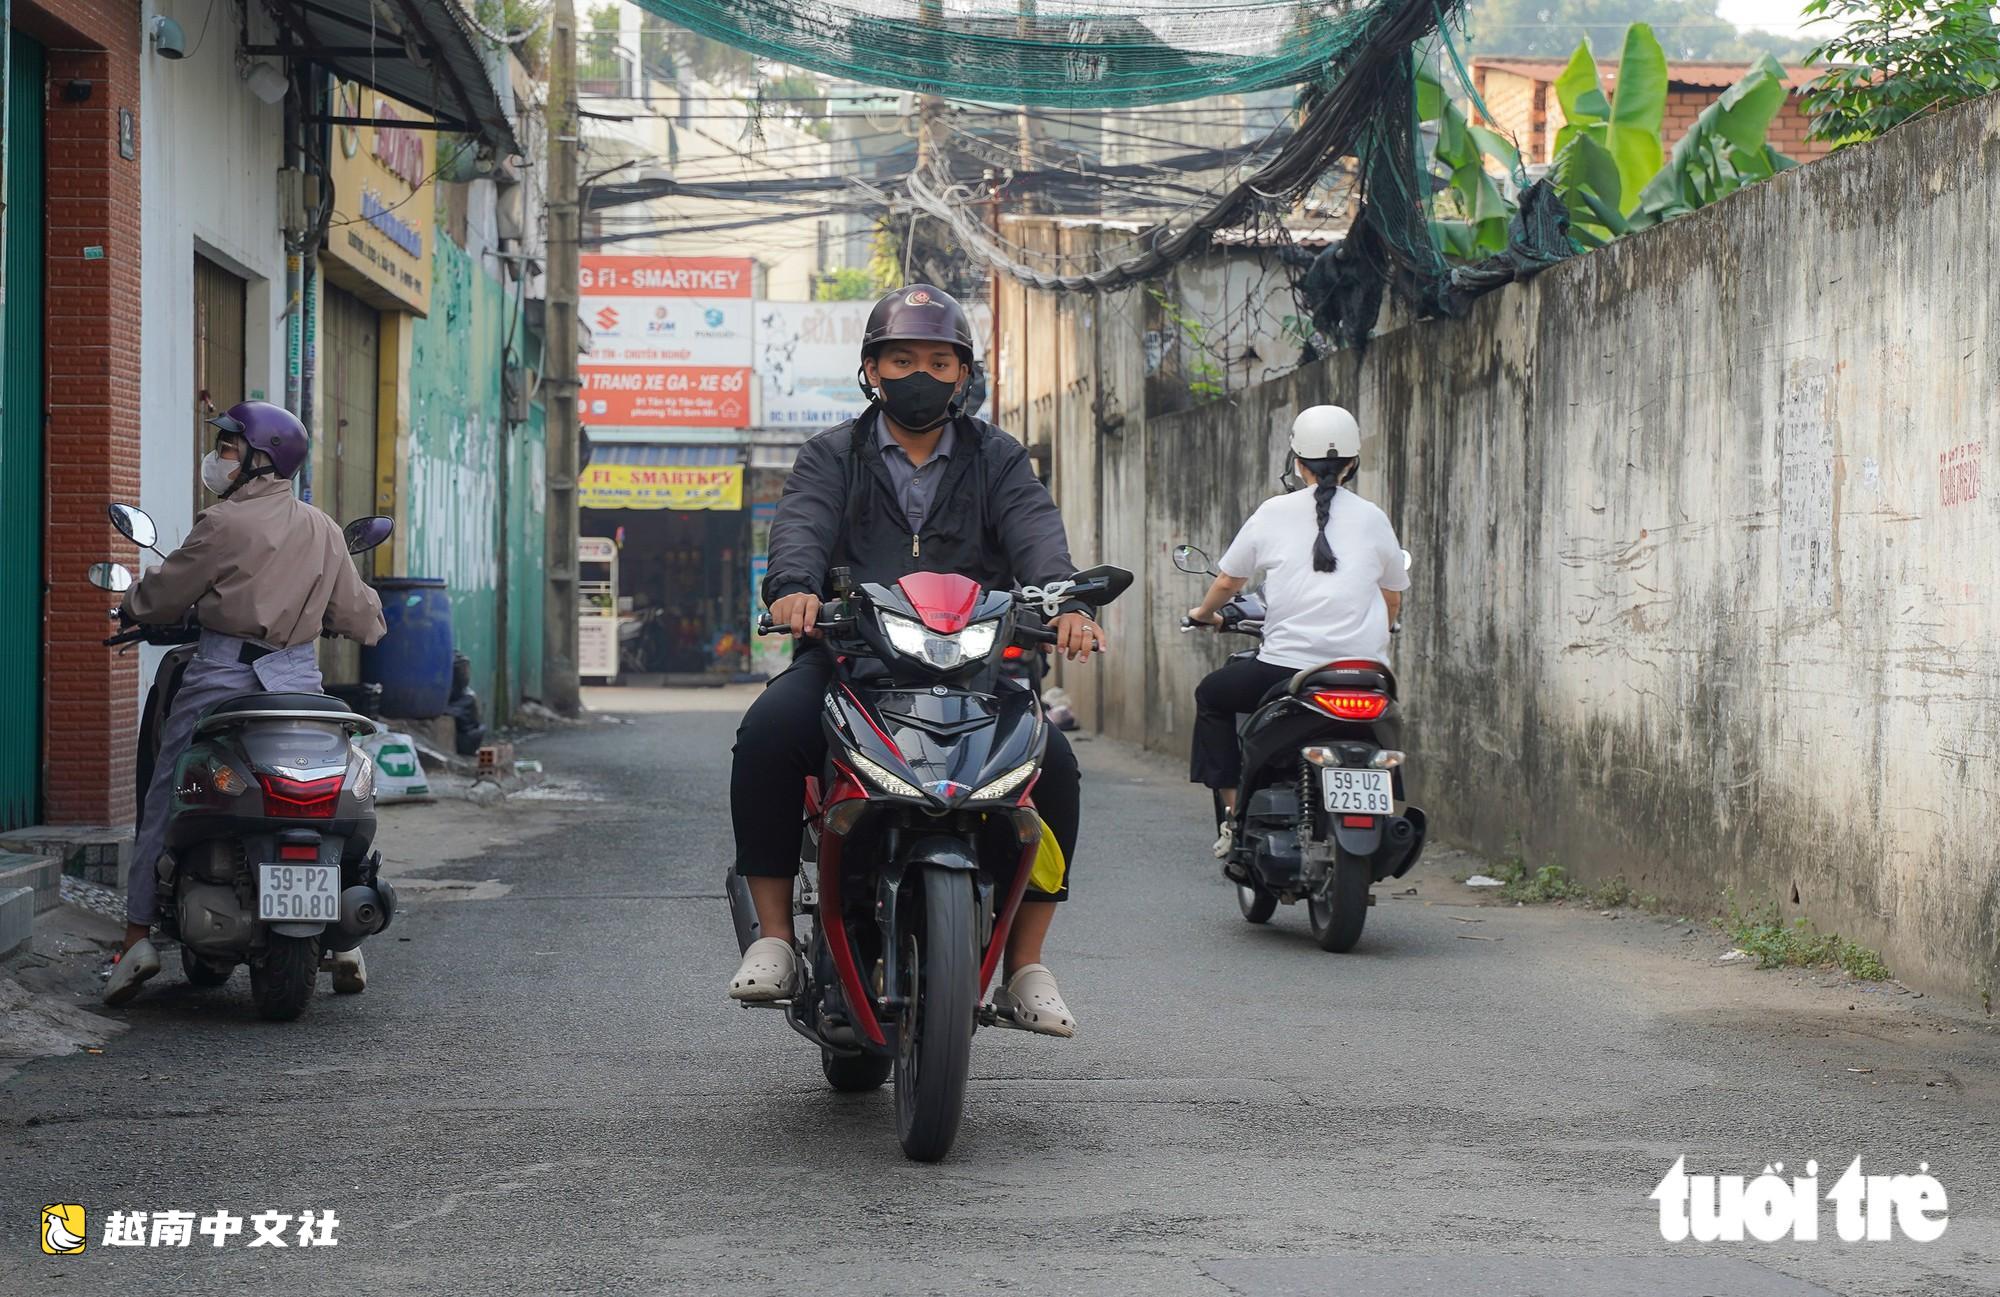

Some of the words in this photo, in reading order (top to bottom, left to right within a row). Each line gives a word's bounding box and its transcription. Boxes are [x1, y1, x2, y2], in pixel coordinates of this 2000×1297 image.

[124, 114, 131, 140] 2
[598, 268, 616, 288] FI
[632, 269, 740, 290] SMARTKEY
[592, 373, 641, 390] TRANG
[644, 374, 666, 390] XE
[667, 374, 688, 390] GA
[699, 375, 720, 391] XE
[721, 370, 744, 392] SỐ
[630, 471, 734, 485] SMARTKEY
[1334, 771, 1381, 791] 59-U2
[1330, 792, 1388, 811] 225.89
[270, 867, 329, 892] 59-P2
[262, 894, 336, 918] 050.80
